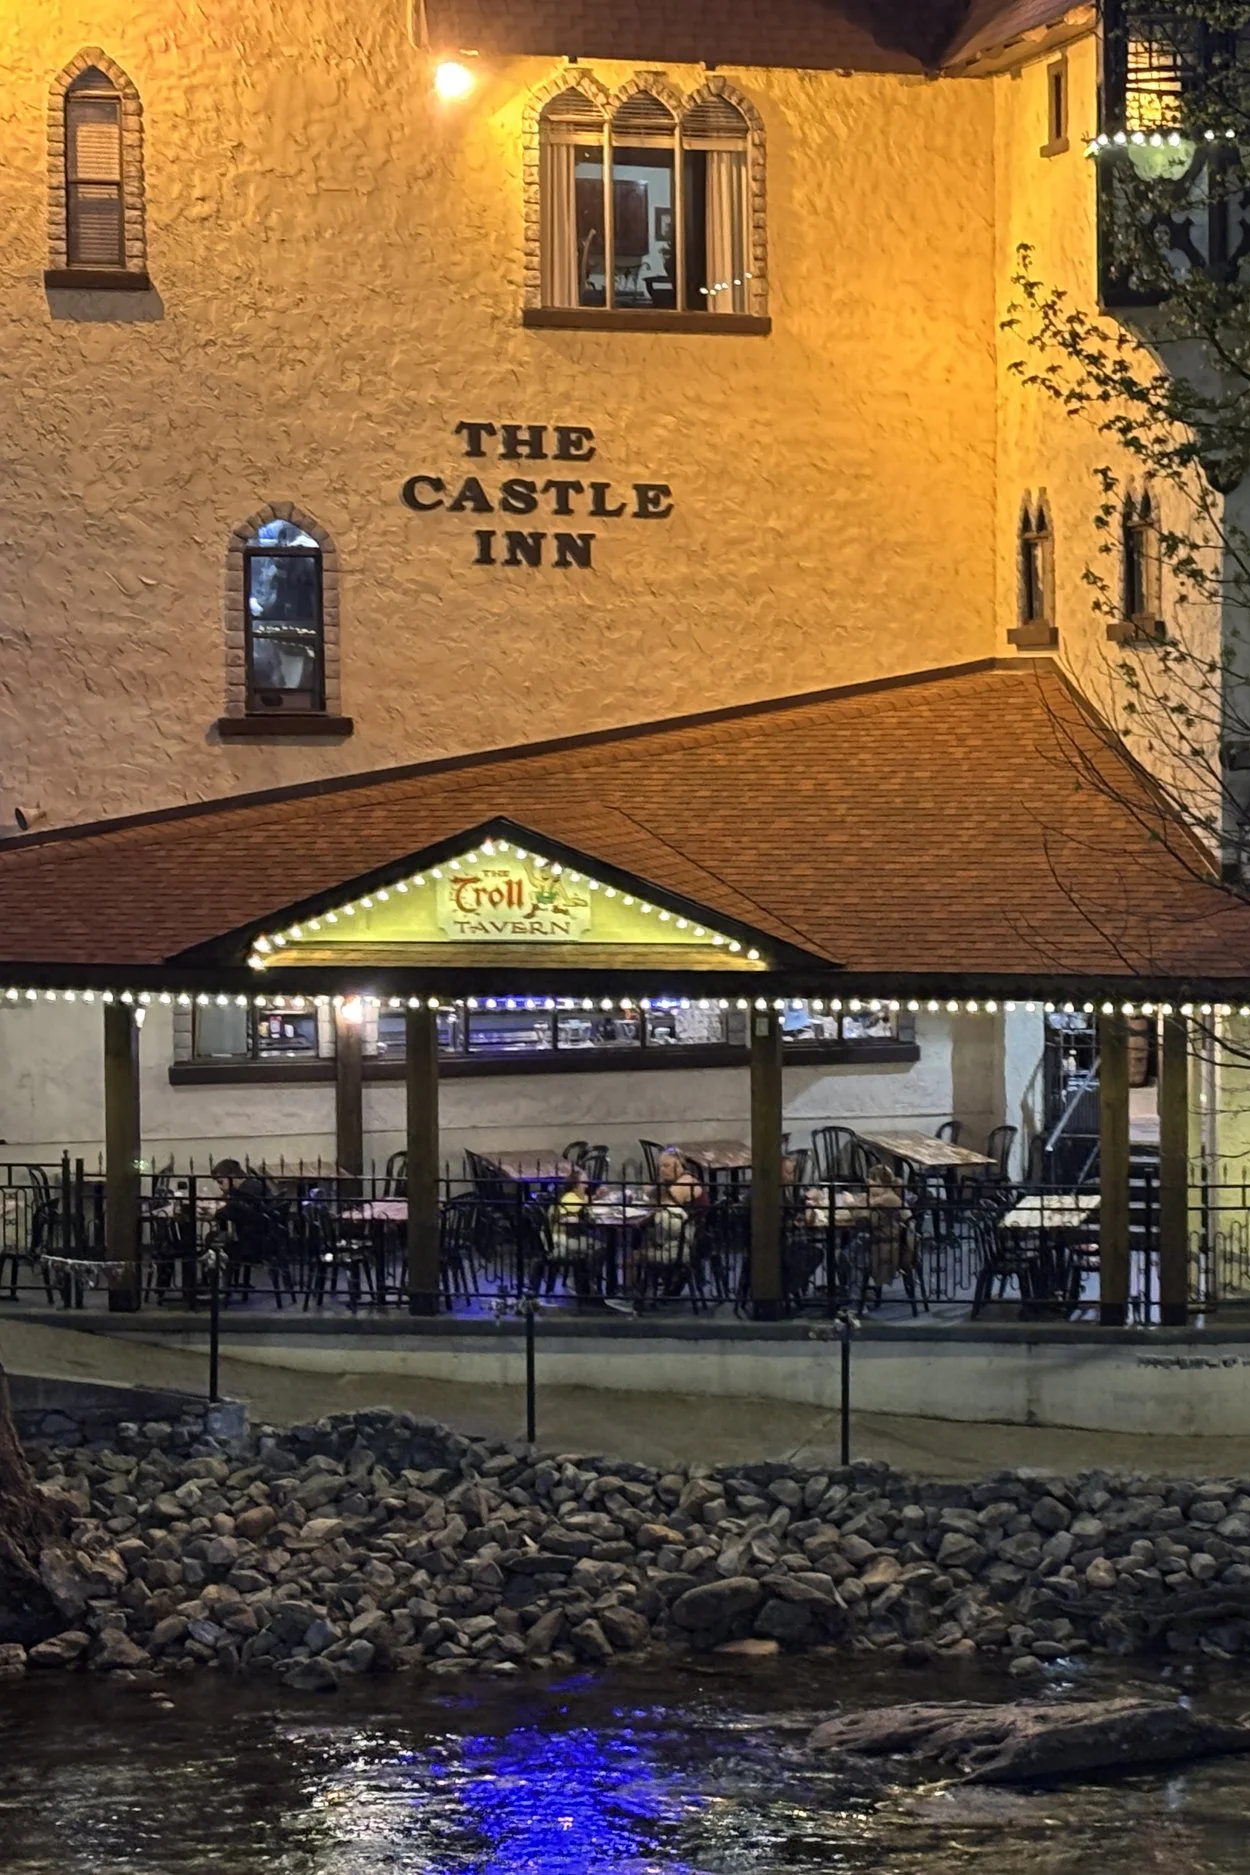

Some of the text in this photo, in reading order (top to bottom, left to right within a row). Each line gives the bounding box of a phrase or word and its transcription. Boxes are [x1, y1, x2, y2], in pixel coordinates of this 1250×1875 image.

[455, 420, 596, 461] THE
[402, 475, 674, 518] CASTLE
[472, 529, 596, 567] INN
[482, 869, 510, 877] THE
[450, 875, 524, 913] Troll
[454, 920, 571, 935] TAVERN
